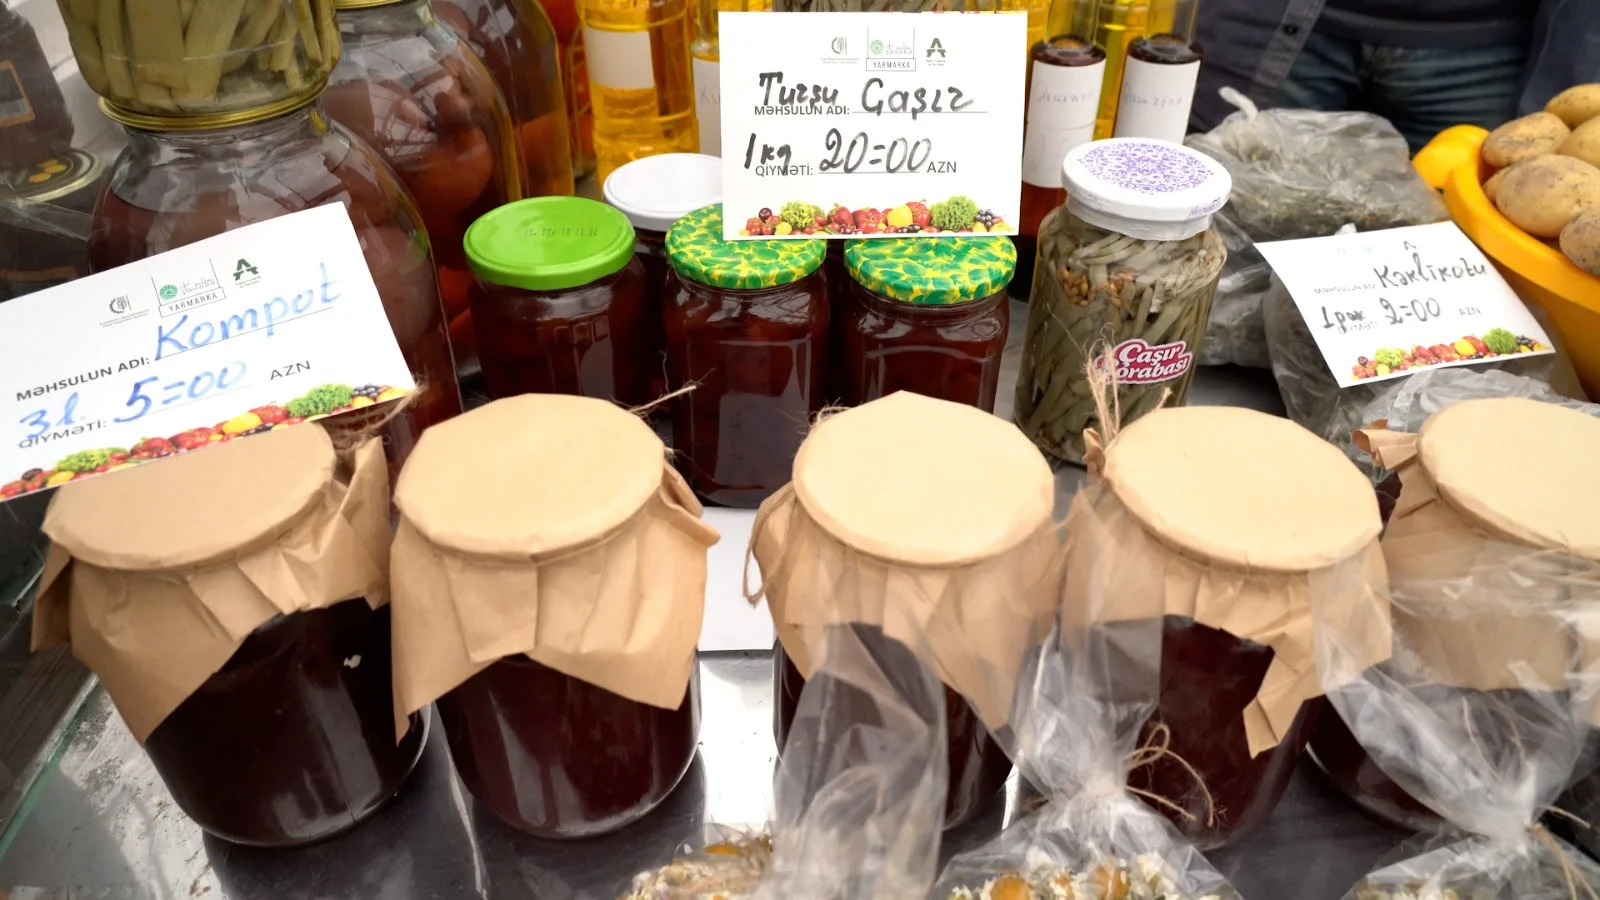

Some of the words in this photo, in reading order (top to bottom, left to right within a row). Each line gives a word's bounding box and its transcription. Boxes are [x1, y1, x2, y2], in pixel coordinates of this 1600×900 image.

[872, 61, 911, 69] YARMARKA
[754, 106, 822, 115] MƏHSULUN
[826, 105, 850, 115] ADI:
[761, 143, 792, 176] kg
[818, 128, 932, 174] 20=00
[927, 161, 957, 174] AZN
[168, 292, 219, 312] YARMARKA
[1379, 297, 1441, 326] 2=00
[16, 366, 113, 402] MƏHSULUN
[118, 356, 150, 373] ADI:
[154, 262, 346, 361] Kompot
[1119, 343, 1181, 368] Çaşır
[269, 360, 312, 381] AZN
[113, 360, 248, 423] 5=00
